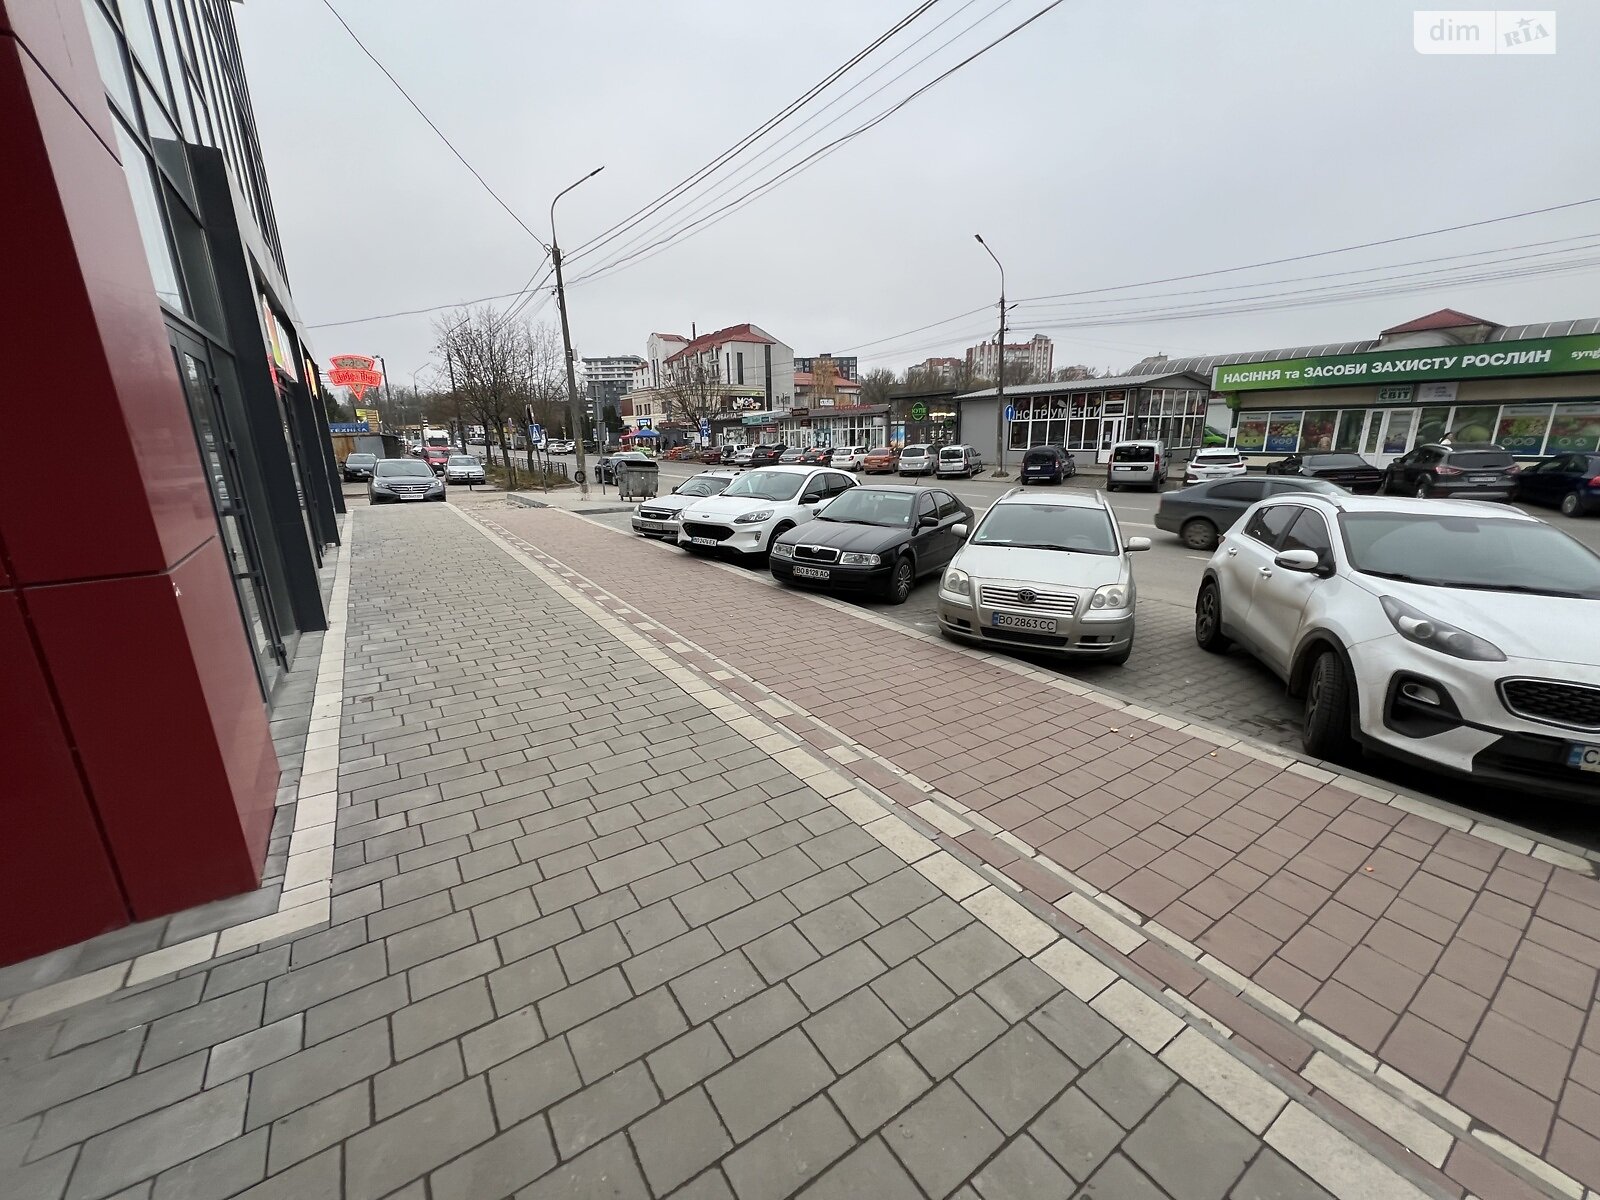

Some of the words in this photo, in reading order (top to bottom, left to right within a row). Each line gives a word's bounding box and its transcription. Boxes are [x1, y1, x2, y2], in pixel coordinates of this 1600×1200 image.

[1223, 370, 1280, 383] НАСІННЯ
[1285, 370, 1299, 379] та
[1304, 363, 1367, 378] ЗАСОБИ
[1371, 356, 1458, 373] ЗАХИСТУ
[1461, 350, 1551, 368] РОСЛИН
[999, 615, 1012, 626] BO
[1014, 617, 1038, 629] 2863
[1039, 620, 1055, 631] CC
